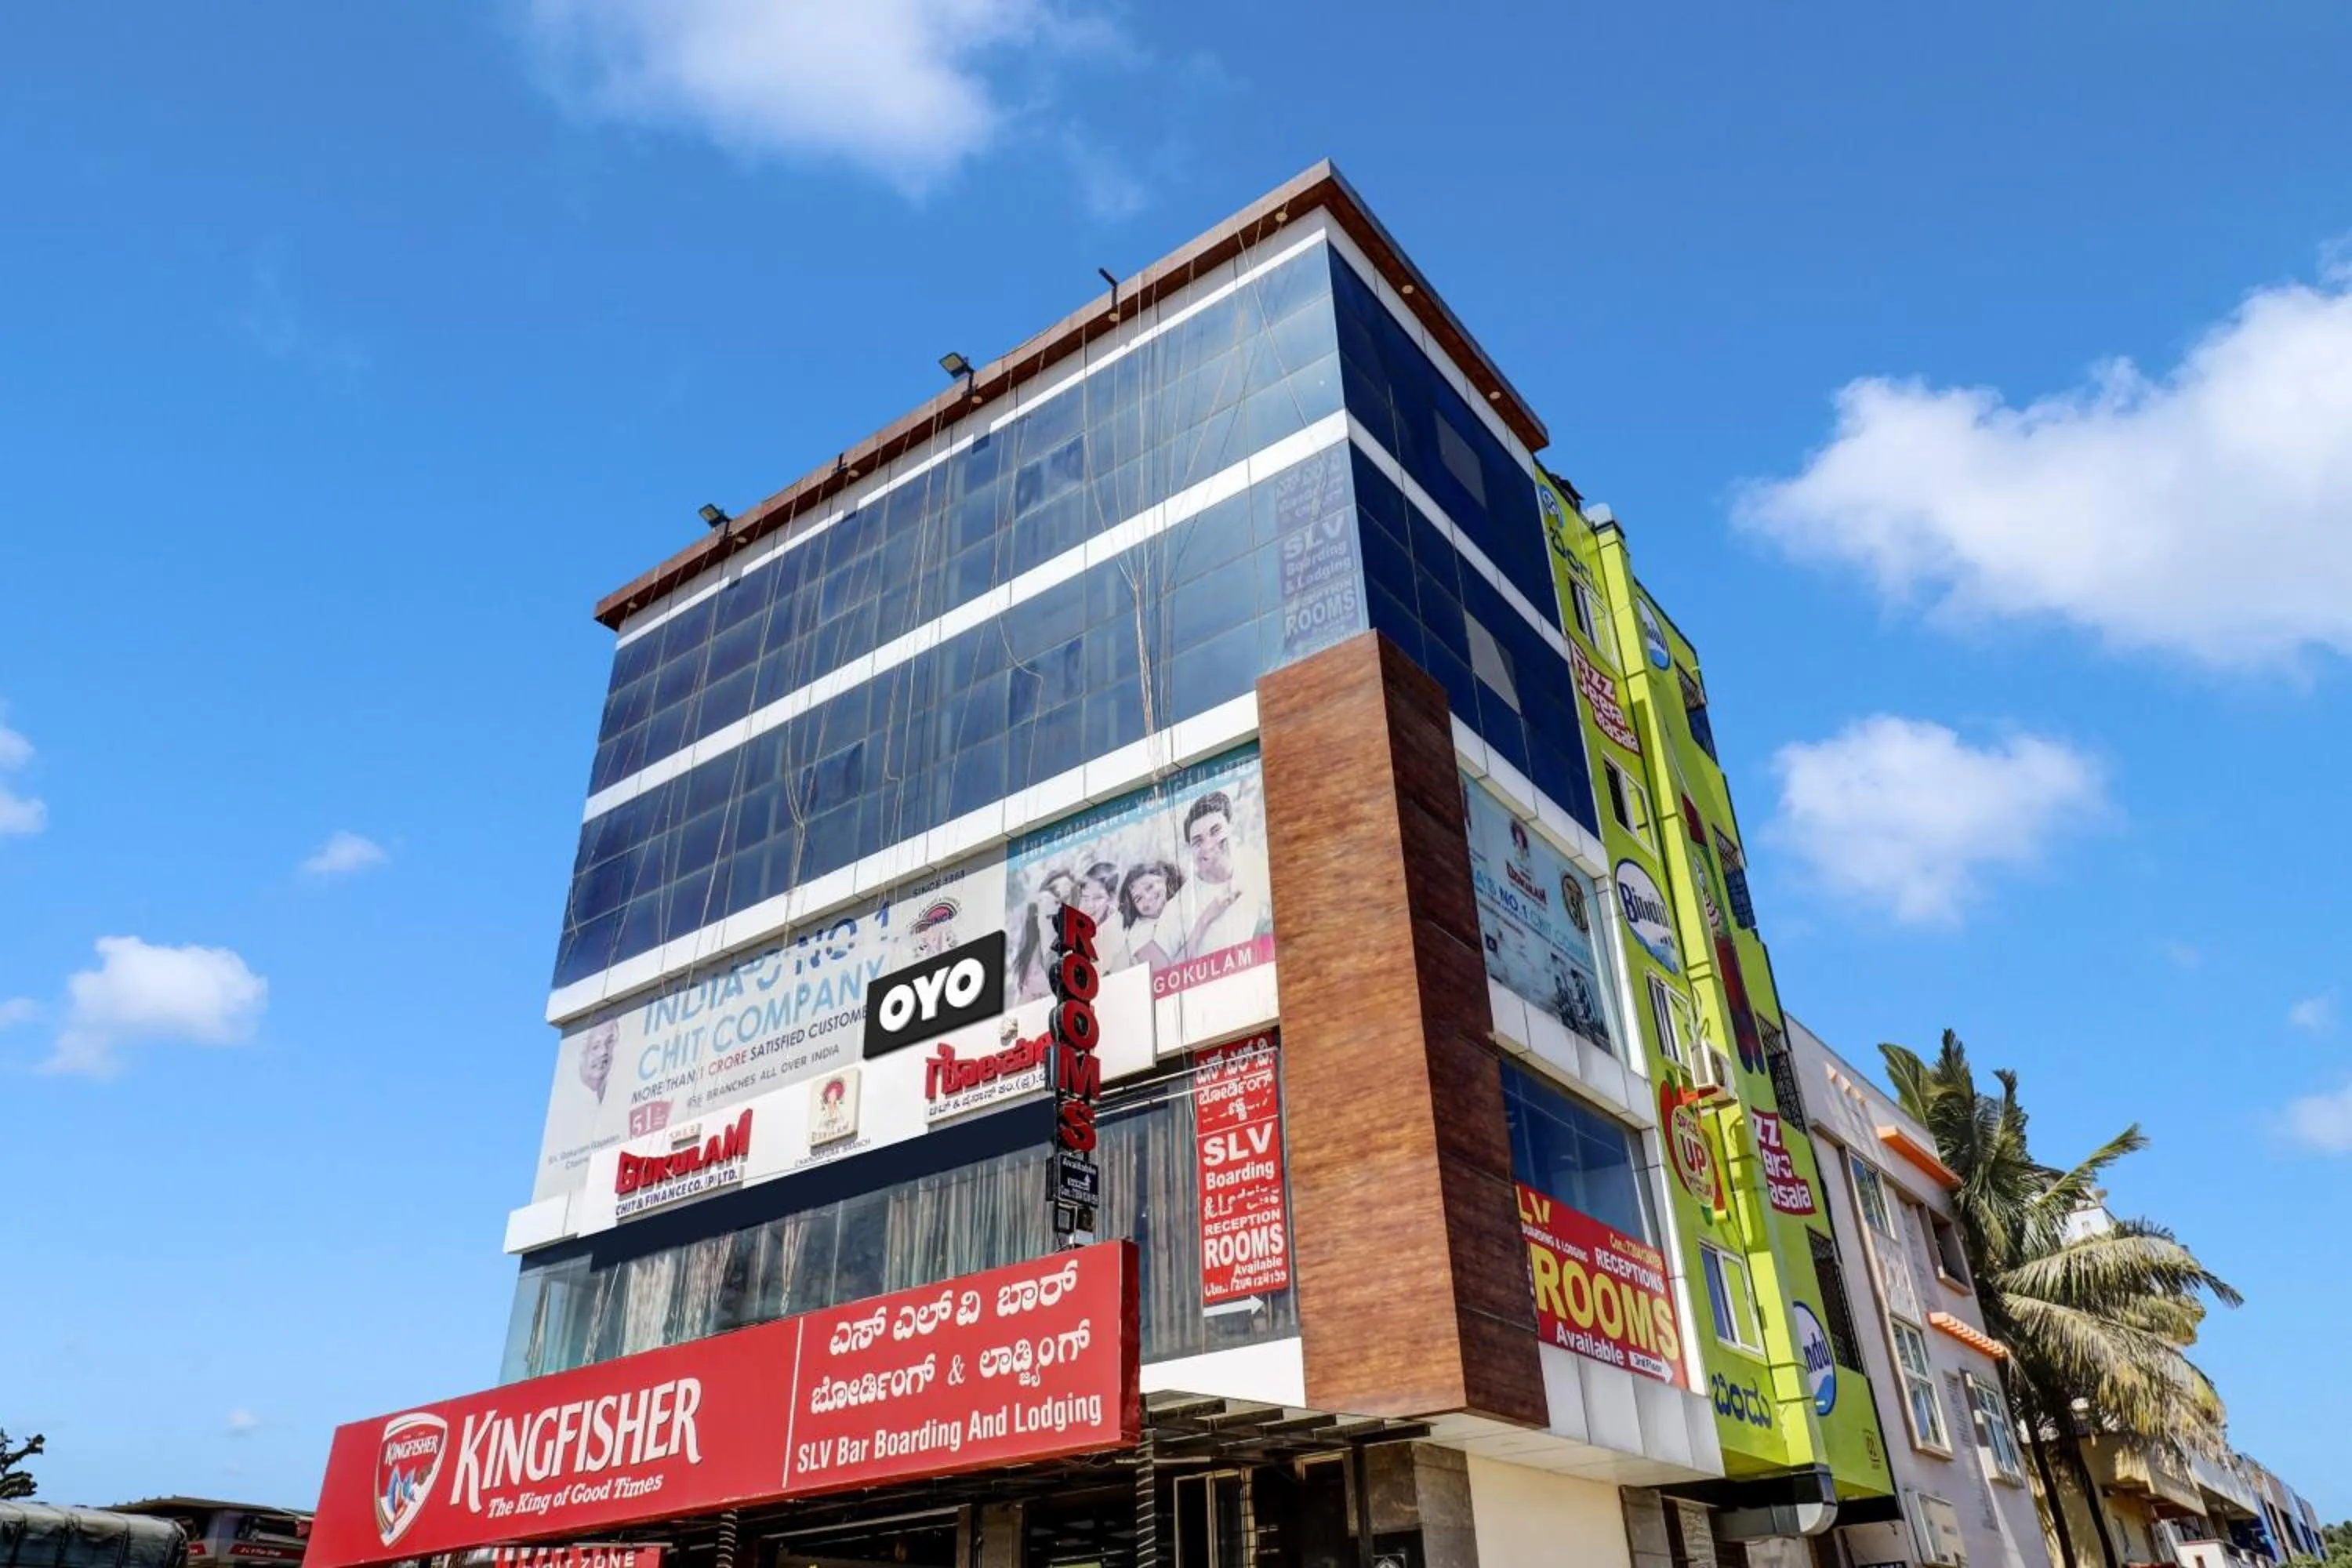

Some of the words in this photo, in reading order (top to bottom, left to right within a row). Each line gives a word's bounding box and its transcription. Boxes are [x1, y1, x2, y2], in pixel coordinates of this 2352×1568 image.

[1285, 590, 1356, 638] ROOMS
[1154, 946, 1252, 993] GOKULAM
[637, 1025, 706, 1081] CHIT
[713, 953, 886, 1053] COMPANY
[879, 957, 985, 1033] OYO
[1058, 902, 1100, 1152] ROOMS
[631, 1080, 663, 1105] MORE
[665, 1068, 697, 1092] THAN
[709, 1050, 748, 1076] CRORE
[750, 1029, 805, 1061] SATISFIED
[808, 1004, 867, 1040] CUSTOME
[706, 1073, 756, 1102] BRANCHES
[760, 1068, 778, 1080] ALL
[781, 1055, 807, 1073] OVER
[811, 1044, 840, 1063] INDIA
[1203, 1123, 1273, 1167] SLV
[645, 1184, 686, 1207] FINANCE
[1205, 1160, 1275, 1191] Boarding
[1769, 1179, 1813, 1208] asala
[1204, 1208, 1280, 1236] RECEPTION
[1515, 1185, 1551, 1224] LV
[1204, 1222, 1284, 1270] ROOMS
[1233, 1255, 1283, 1277] Available
[1594, 1247, 1664, 1294] RECEPTIONS
[829, 1305, 887, 1356] ಎಸ್
[892, 1290, 953, 1341] ಎಲ್
[996, 1259, 1078, 1317] ಬಾರ್
[1530, 1242, 1679, 1361] ROOMS
[1555, 1321, 1624, 1366] Available
[1803, 1332, 1831, 1374] ndu
[947, 1354, 966, 1386] &
[385, 1435, 439, 1466] KINGFISHER
[449, 1377, 703, 1514] KINGFISHER
[797, 1439, 833, 1473] SLV
[836, 1436, 868, 1466] Bar
[873, 1418, 962, 1460] Boarding
[967, 1406, 1008, 1442] And
[1014, 1392, 1102, 1433] Lodging
[487, 1497, 513, 1519] The
[515, 1492, 550, 1515] King
[553, 1487, 569, 1507] of
[571, 1479, 612, 1504] Good
[614, 1473, 664, 1499] Times
